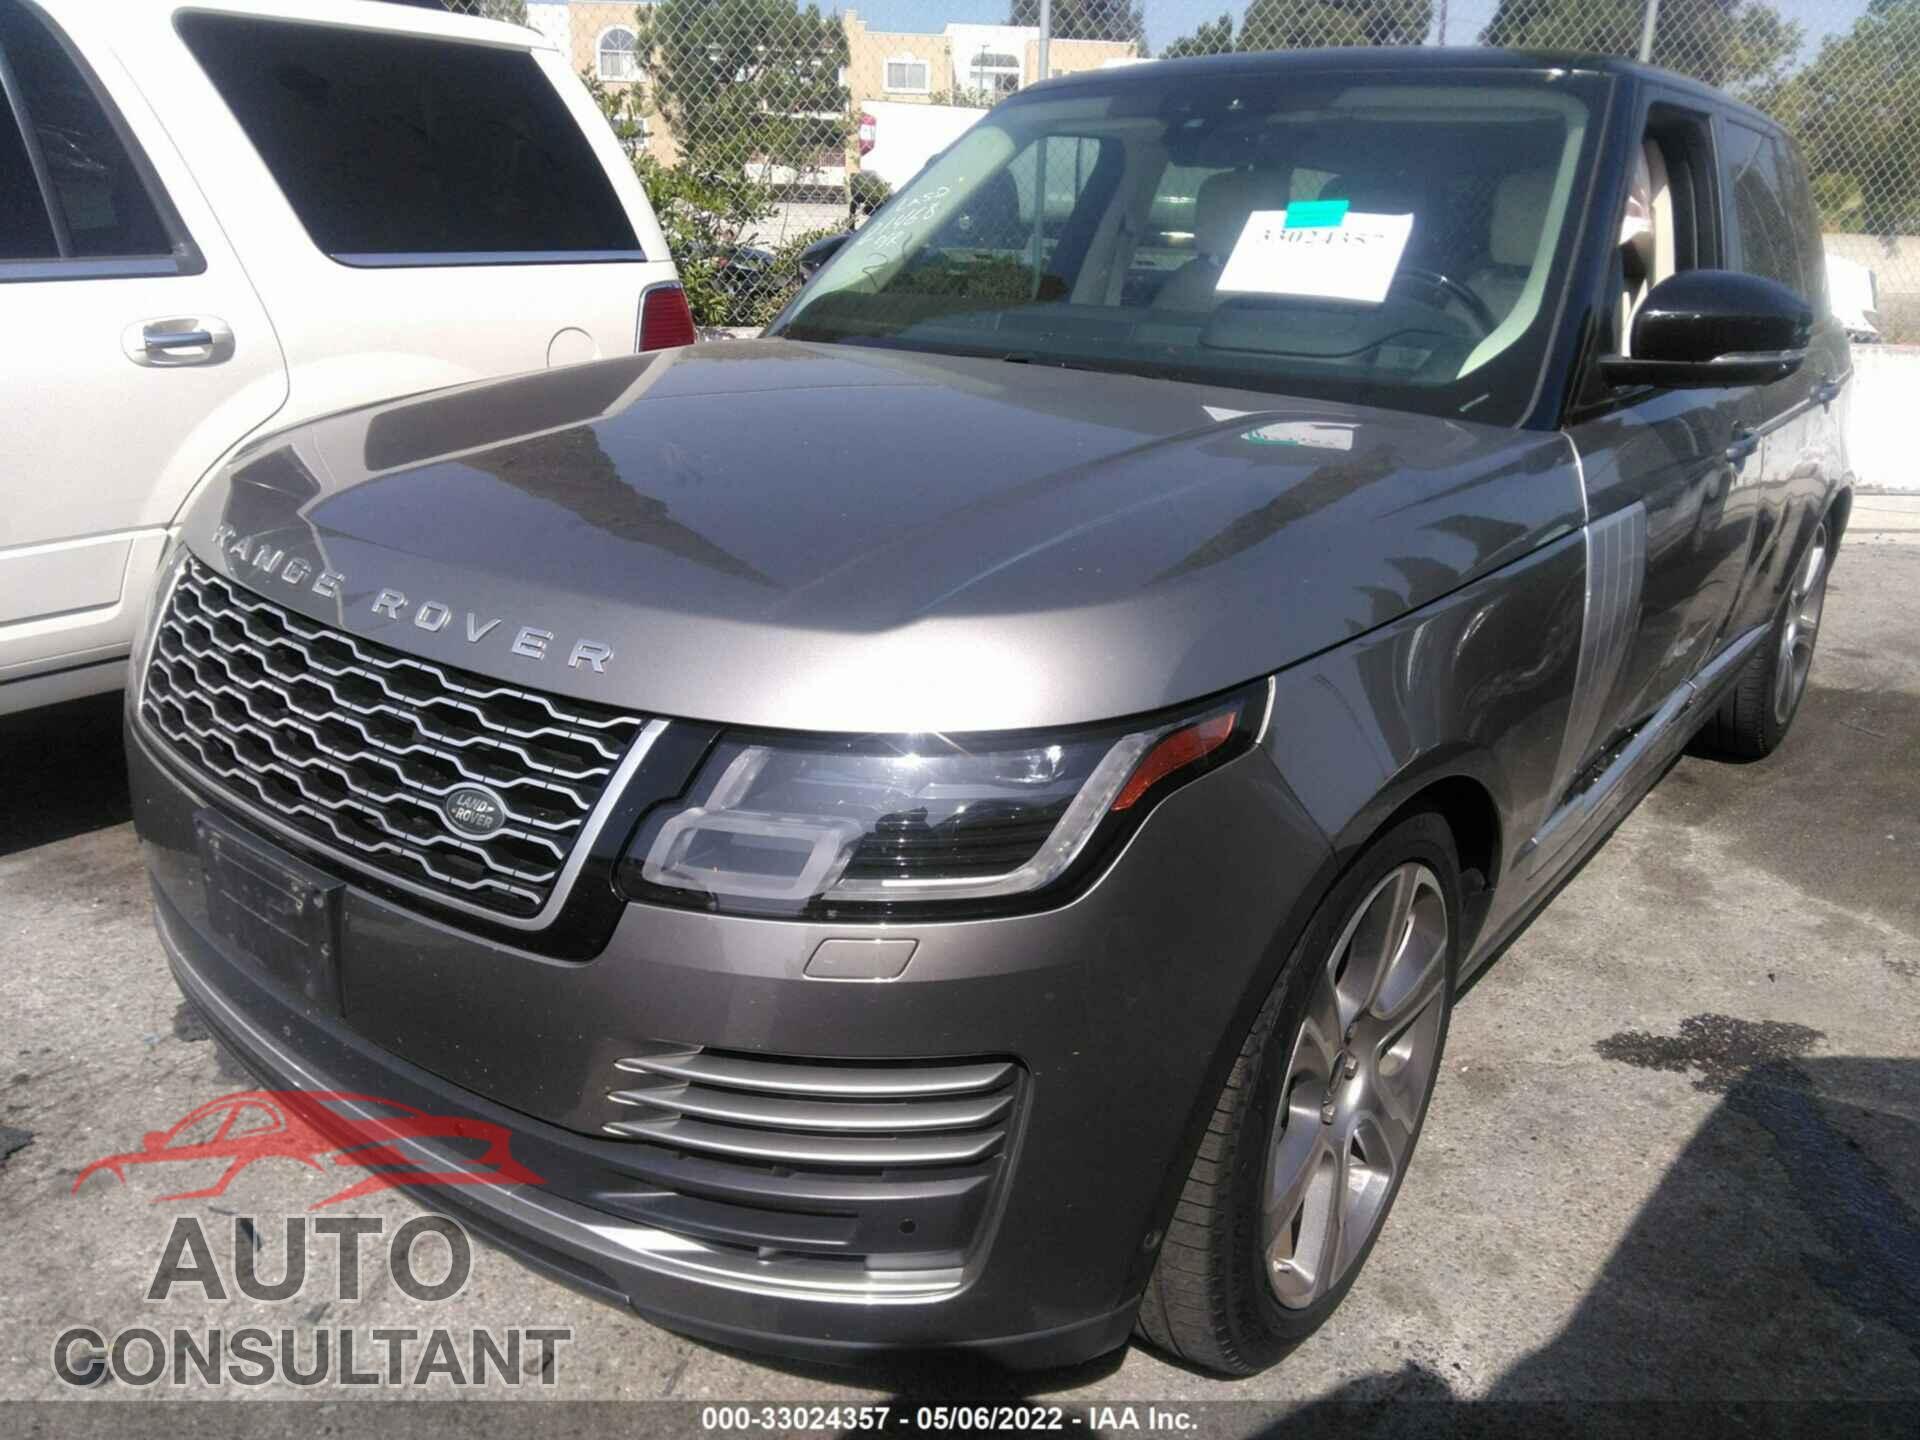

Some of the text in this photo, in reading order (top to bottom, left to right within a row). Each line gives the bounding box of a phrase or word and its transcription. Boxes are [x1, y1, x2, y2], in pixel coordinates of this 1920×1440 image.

[211, 525, 615, 674] RANGE ROVER
[456, 793, 488, 812] LAND
[455, 807, 494, 829] ROVER
